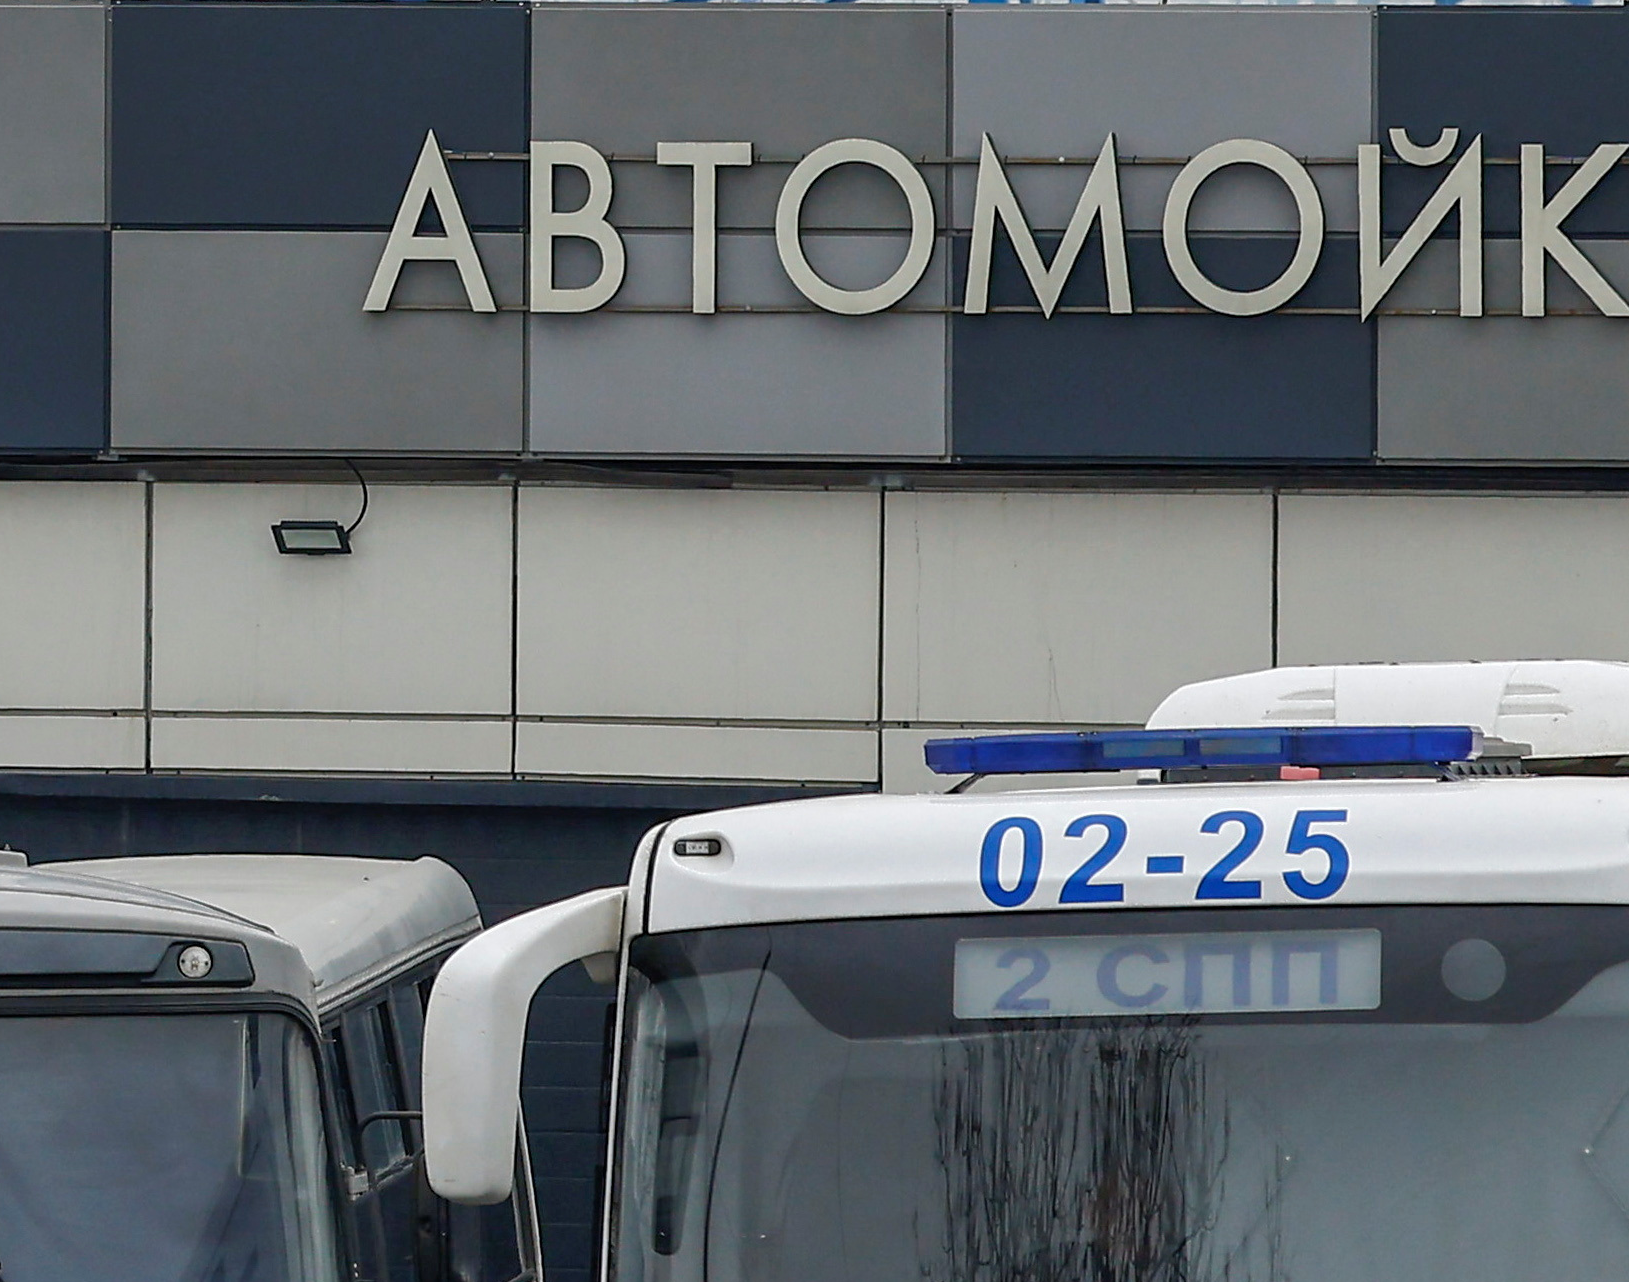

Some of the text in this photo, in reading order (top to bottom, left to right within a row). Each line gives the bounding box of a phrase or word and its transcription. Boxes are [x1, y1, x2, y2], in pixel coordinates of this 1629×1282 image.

[980, 809, 1350, 908] 02-25
[992, 941, 1339, 1011] 2 СПП
